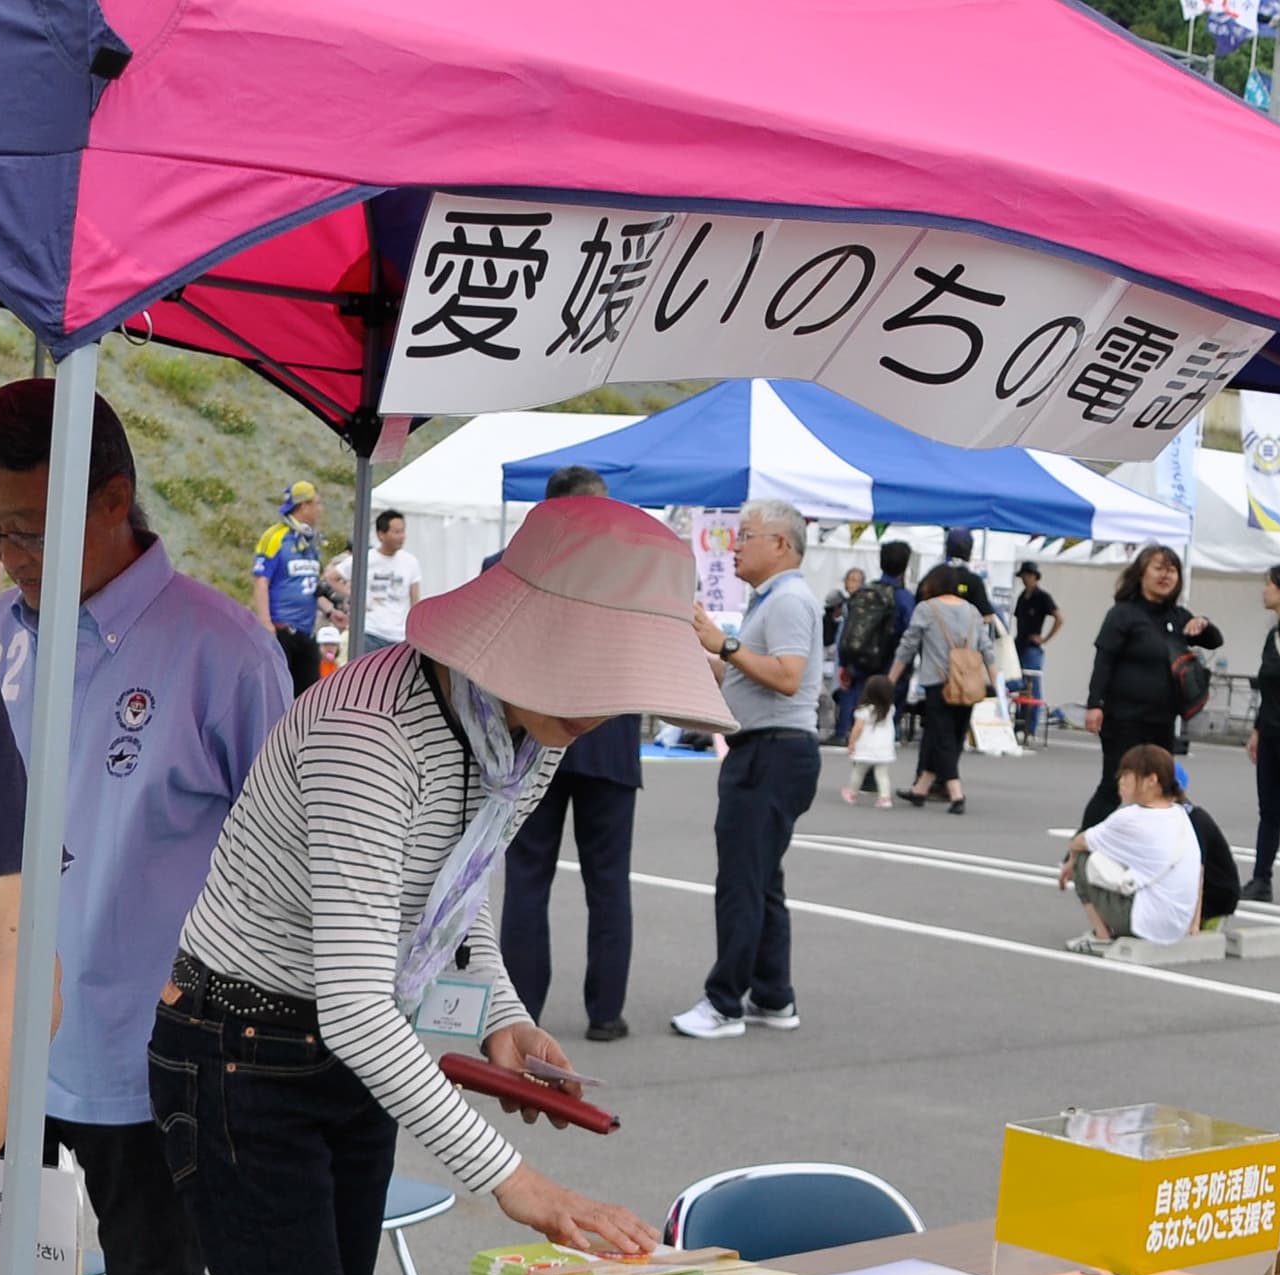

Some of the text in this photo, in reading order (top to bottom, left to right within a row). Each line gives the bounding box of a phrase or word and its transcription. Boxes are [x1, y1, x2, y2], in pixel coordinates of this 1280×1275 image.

[406, 211, 1250, 432] 愛媛いのちの電話
[1155, 1164, 1277, 1217] 自殺予防活動に
[1145, 1199, 1277, 1254] あなたのご支援を
